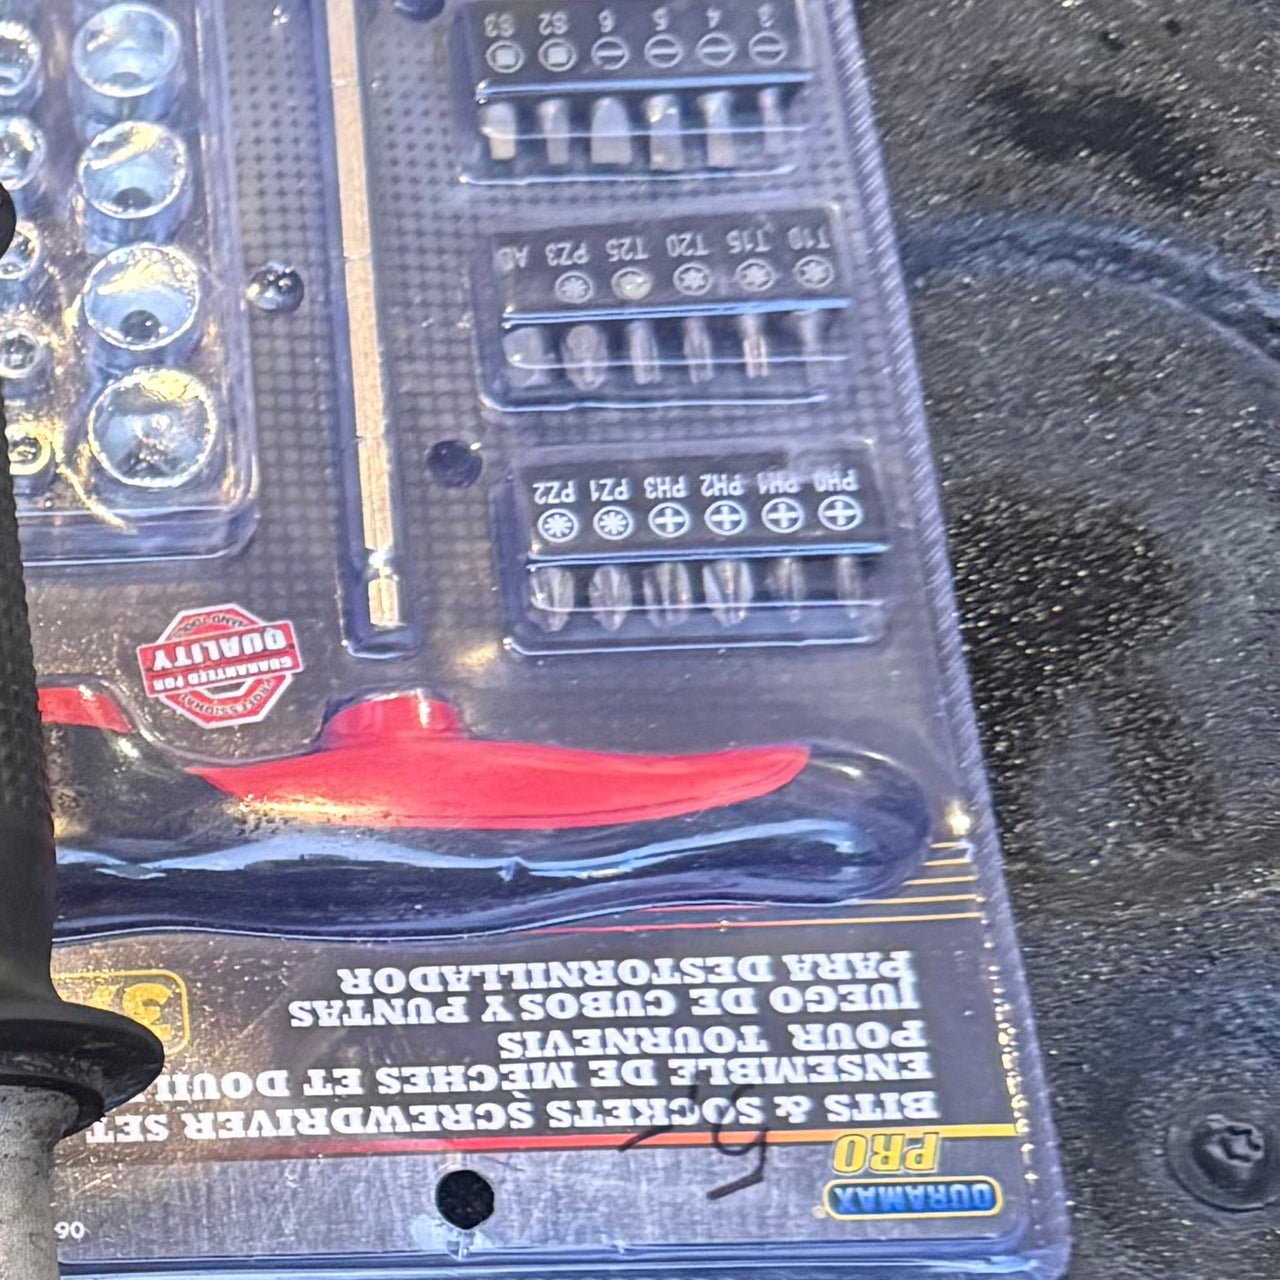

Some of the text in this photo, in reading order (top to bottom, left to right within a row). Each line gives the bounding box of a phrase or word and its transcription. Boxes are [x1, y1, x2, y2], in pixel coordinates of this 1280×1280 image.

[599, 9, 614, 33] 6
[653, 7, 668, 31] 5
[706, 7, 722, 29] 4
[544, 241, 589, 267] PZ3
[605, 236, 650, 263] T25
[666, 232, 711, 258] T20
[727, 227, 773, 255] T15
[532, 481, 578, 506] PZ2
[589, 478, 631, 503] PZ1
[644, 475, 689, 500] PH3
[700, 472, 745, 498] PH2
[757, 469, 802, 496] PH1
[152, 628, 288, 672] QUALITY
[152, 656, 293, 692] GUARANTEED FOR
[337, 950, 916, 996] PARA DESTORNILLADOR
[288, 980, 921, 1028] JUEGO DE CUBOS Y PUNTAS
[496, 1020, 929, 1060] POUR TOURNEVIS
[303, 1067, 364, 1097] ET
[377, 1061, 576, 1101] MÈCHES
[587, 1058, 658, 1088] DE
[667, 1052, 934, 1086] ENSEMBLE
[85, 1091, 940, 1145] BITS & SOCKETS SCREWDRIVER SET
[831, 1132, 940, 1173] PRO
[834, 1183, 994, 1212] DURAMAX
